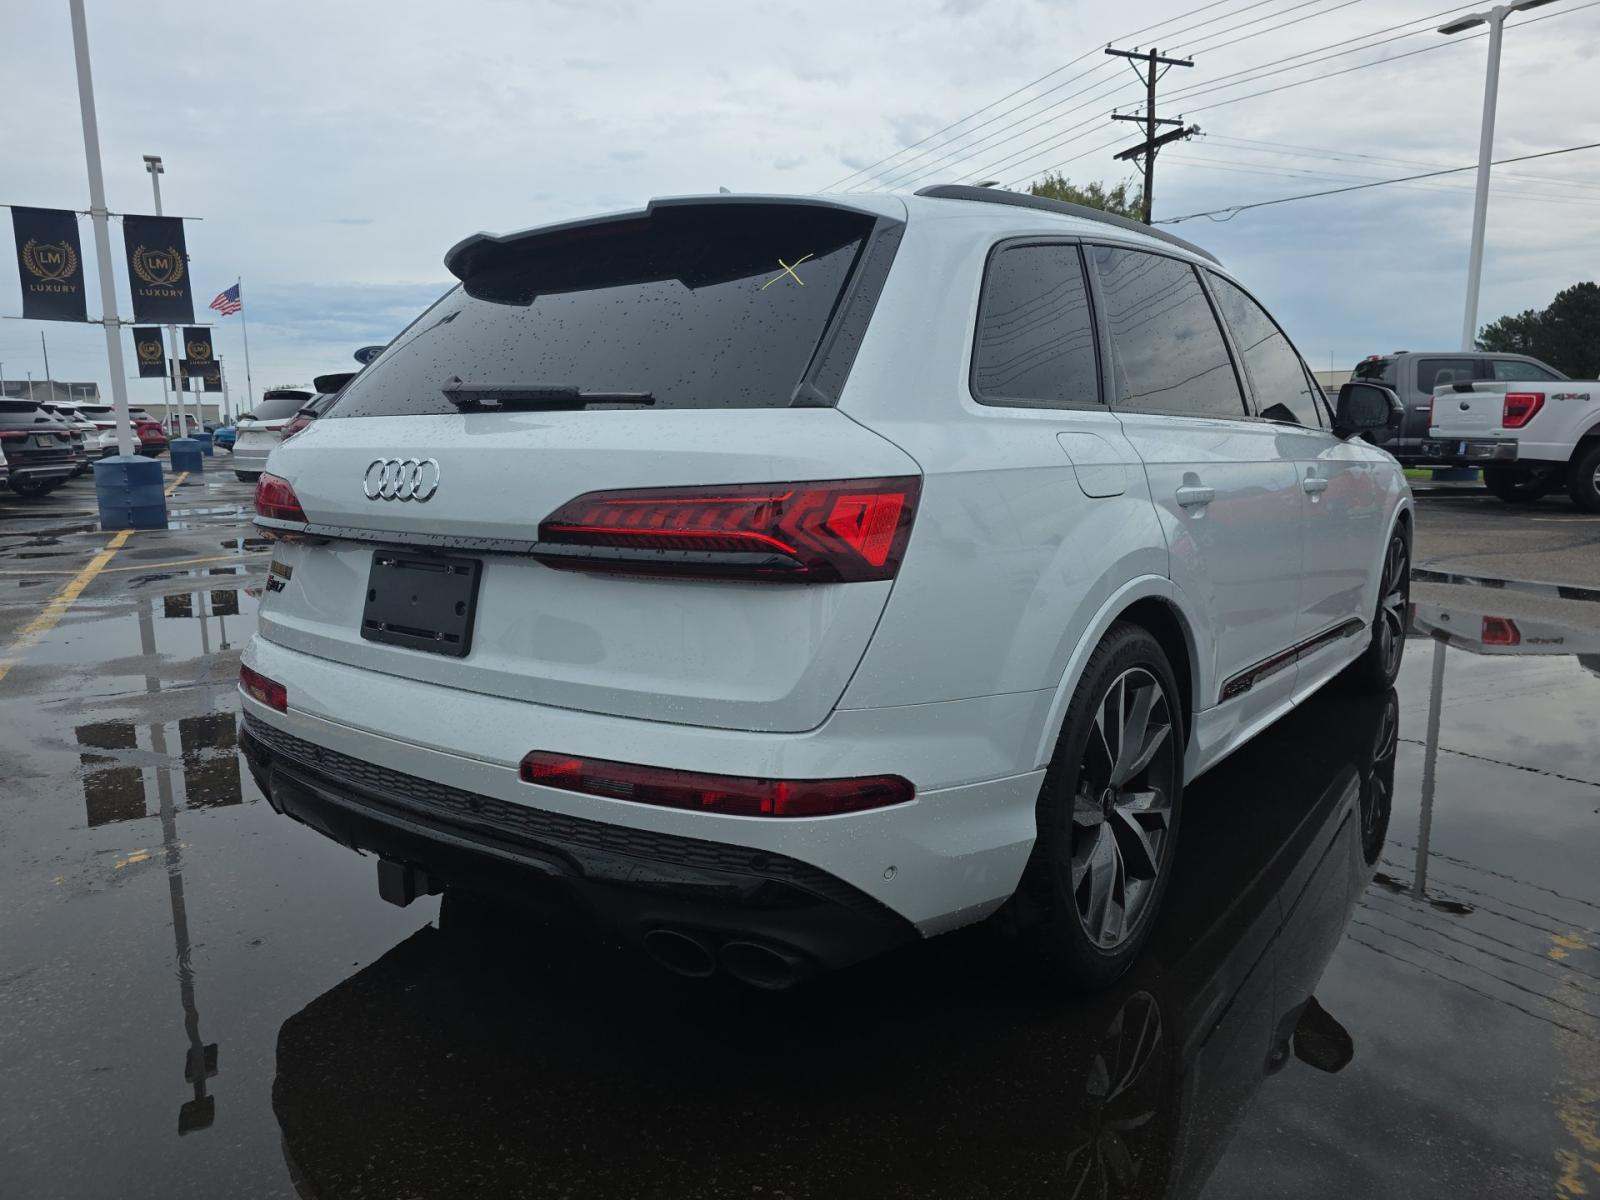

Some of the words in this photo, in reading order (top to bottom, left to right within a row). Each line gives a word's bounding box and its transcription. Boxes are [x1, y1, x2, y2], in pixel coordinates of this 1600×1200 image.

[40, 251, 61, 264] LM
[148, 257, 168, 269] LM
[30, 284, 76, 293] LUXURY
[139, 288, 184, 297] LUXURY
